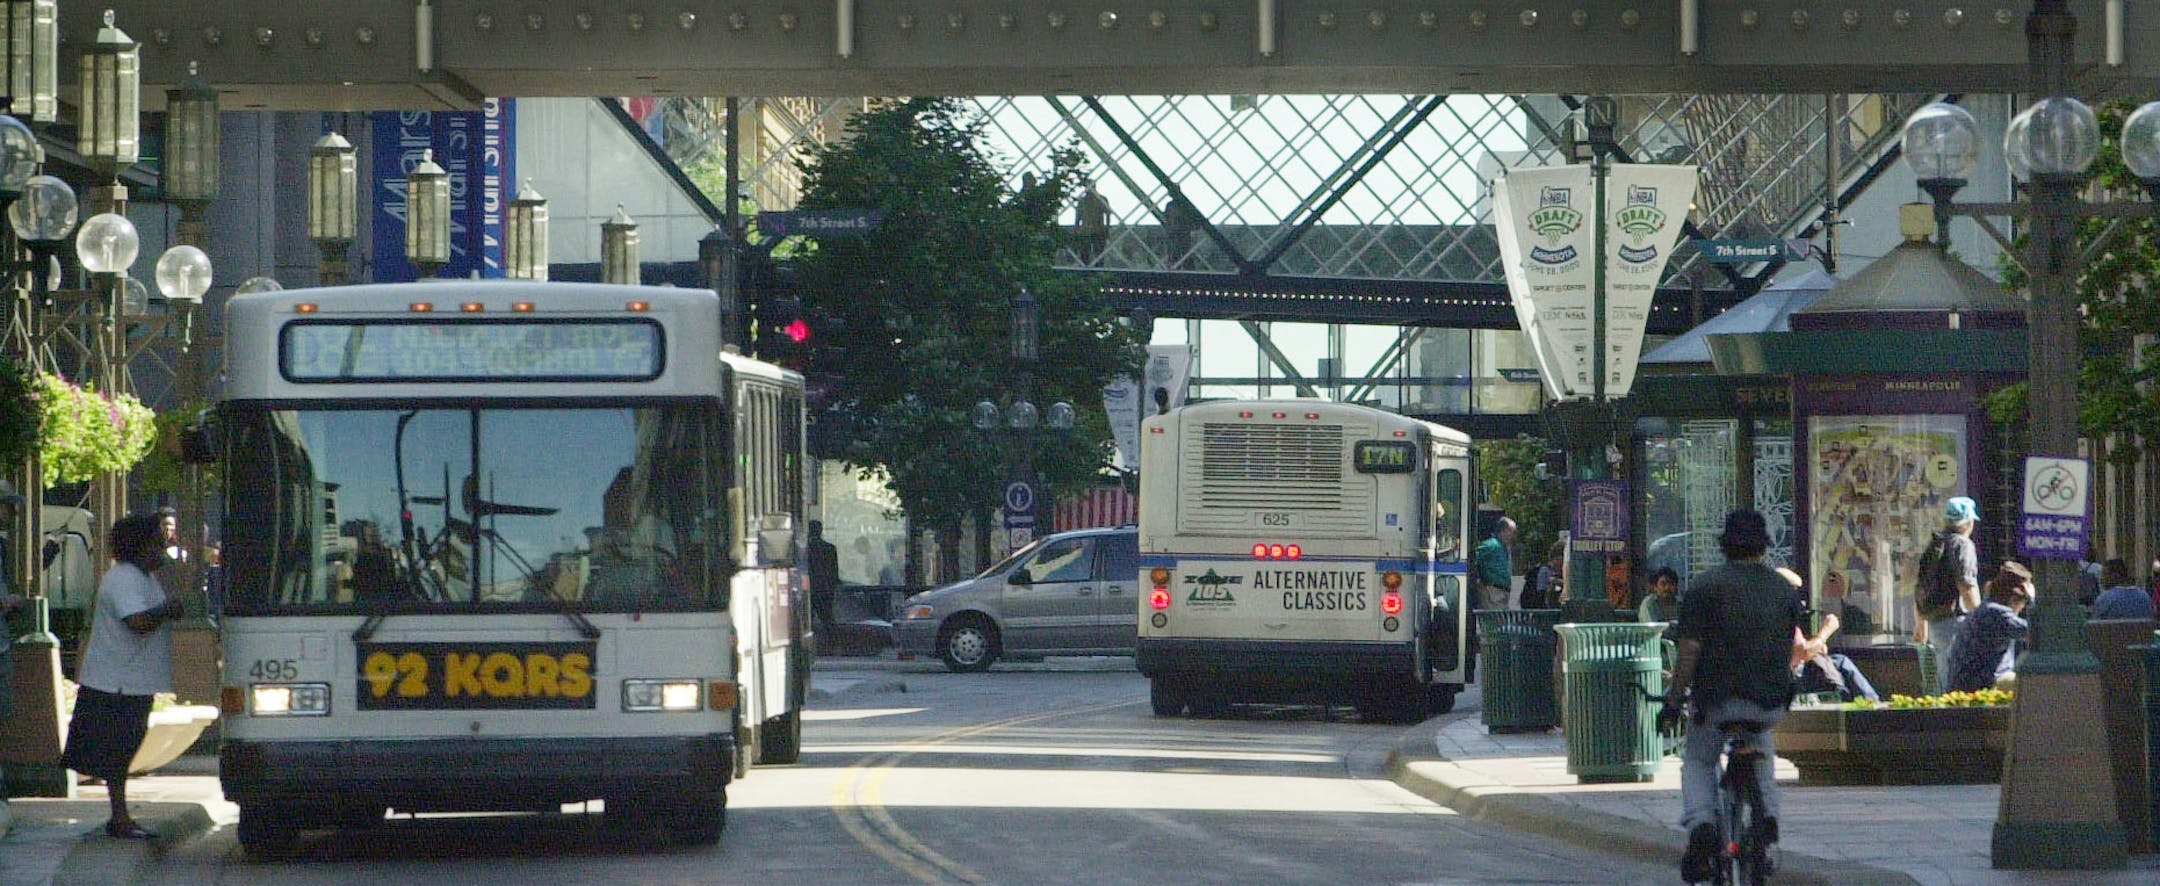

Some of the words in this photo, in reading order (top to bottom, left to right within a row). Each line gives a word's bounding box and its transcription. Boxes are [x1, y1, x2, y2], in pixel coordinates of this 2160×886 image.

[1551, 191, 1567, 204] NBA
[1637, 190, 1653, 204] NBA
[799, 217, 817, 228] 7th
[820, 217, 855, 229] Street
[1535, 209, 1574, 225] DRAFT
[1622, 209, 1660, 225] DRAFT
[1716, 245, 1734, 256] 7th
[1735, 245, 1767, 256] Street
[1885, 381, 1962, 391] MINNEAPOLIS
[1263, 513, 1290, 526] 625
[2025, 518, 2081, 533] 6AM-6PM
[2026, 535, 2080, 550] MON-FRI
[1254, 570, 1367, 590] ALTERNATIVE
[1194, 584, 1229, 599] 105
[1283, 591, 1367, 611] CLASSICS
[249, 659, 298, 681] 495
[364, 650, 428, 698] 92
[446, 650, 593, 698] KQRS
